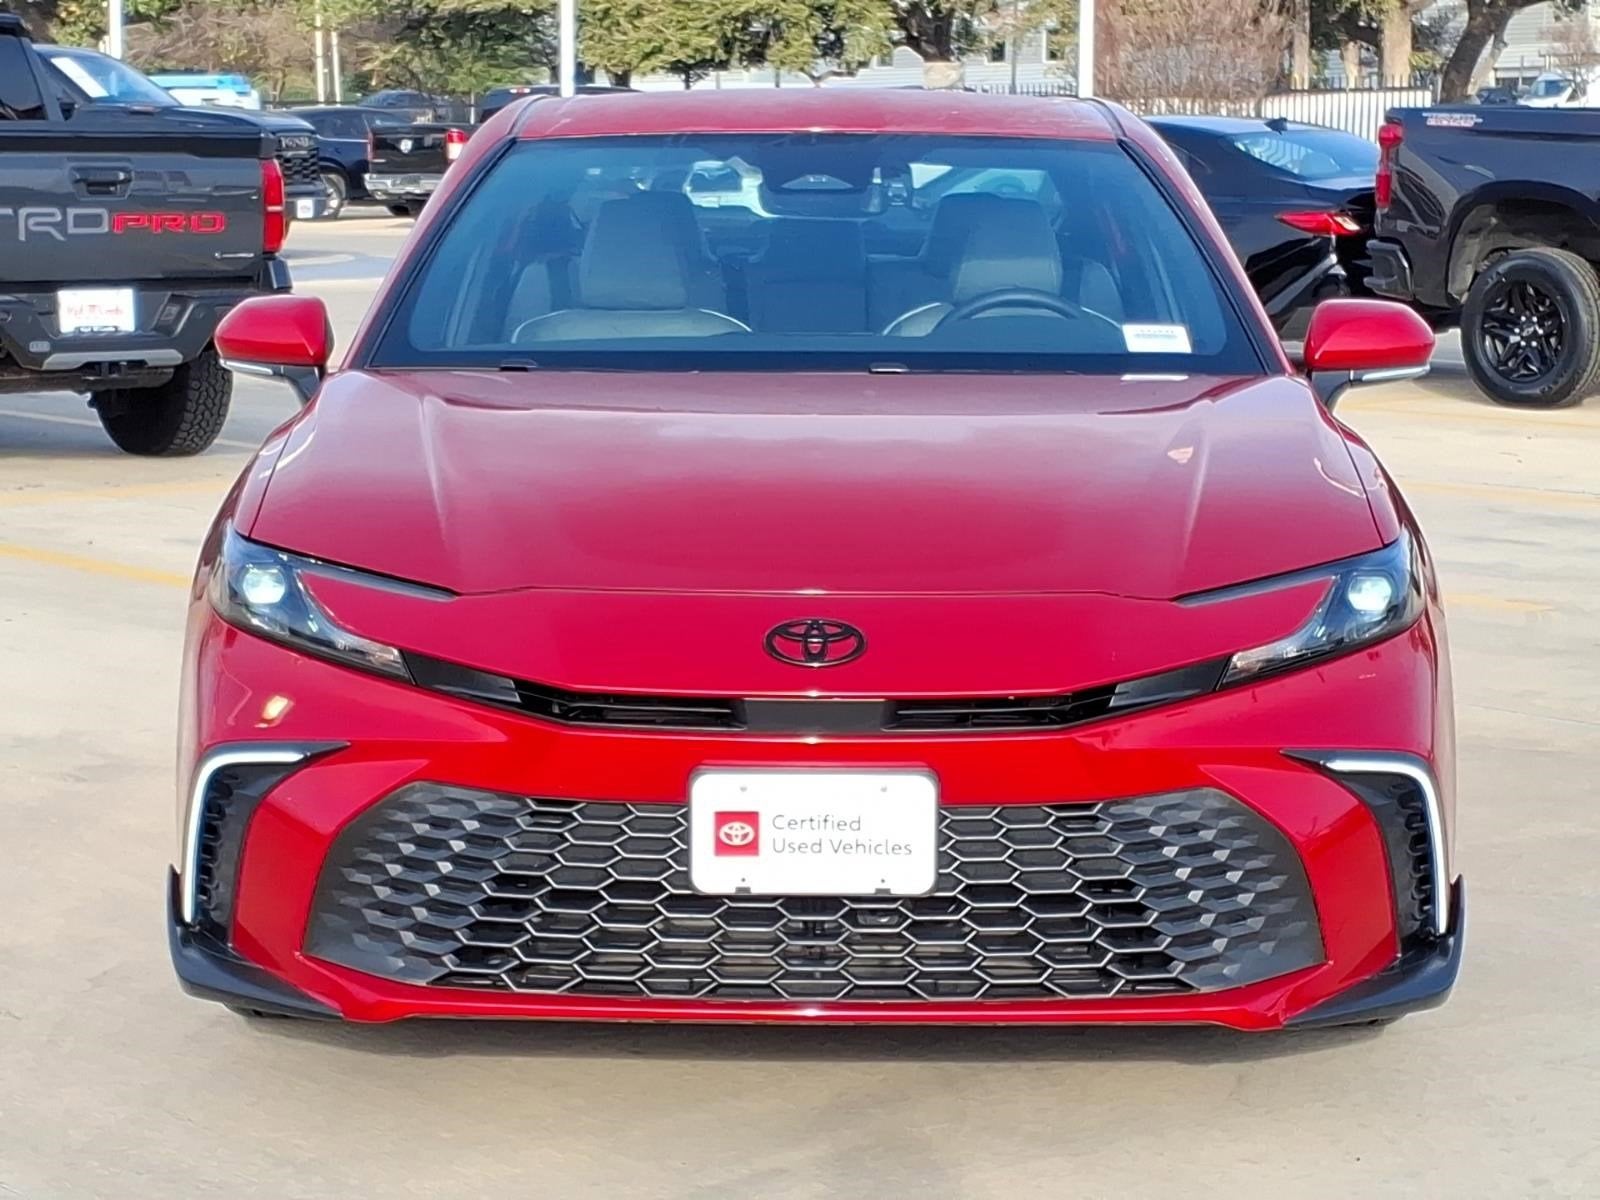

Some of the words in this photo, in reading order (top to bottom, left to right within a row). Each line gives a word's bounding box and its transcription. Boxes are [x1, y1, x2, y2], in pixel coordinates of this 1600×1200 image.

[112, 211, 228, 234] PRO
[772, 814, 862, 832] Certified
[772, 838, 822, 854] Used
[829, 839, 913, 856] Vehicles
